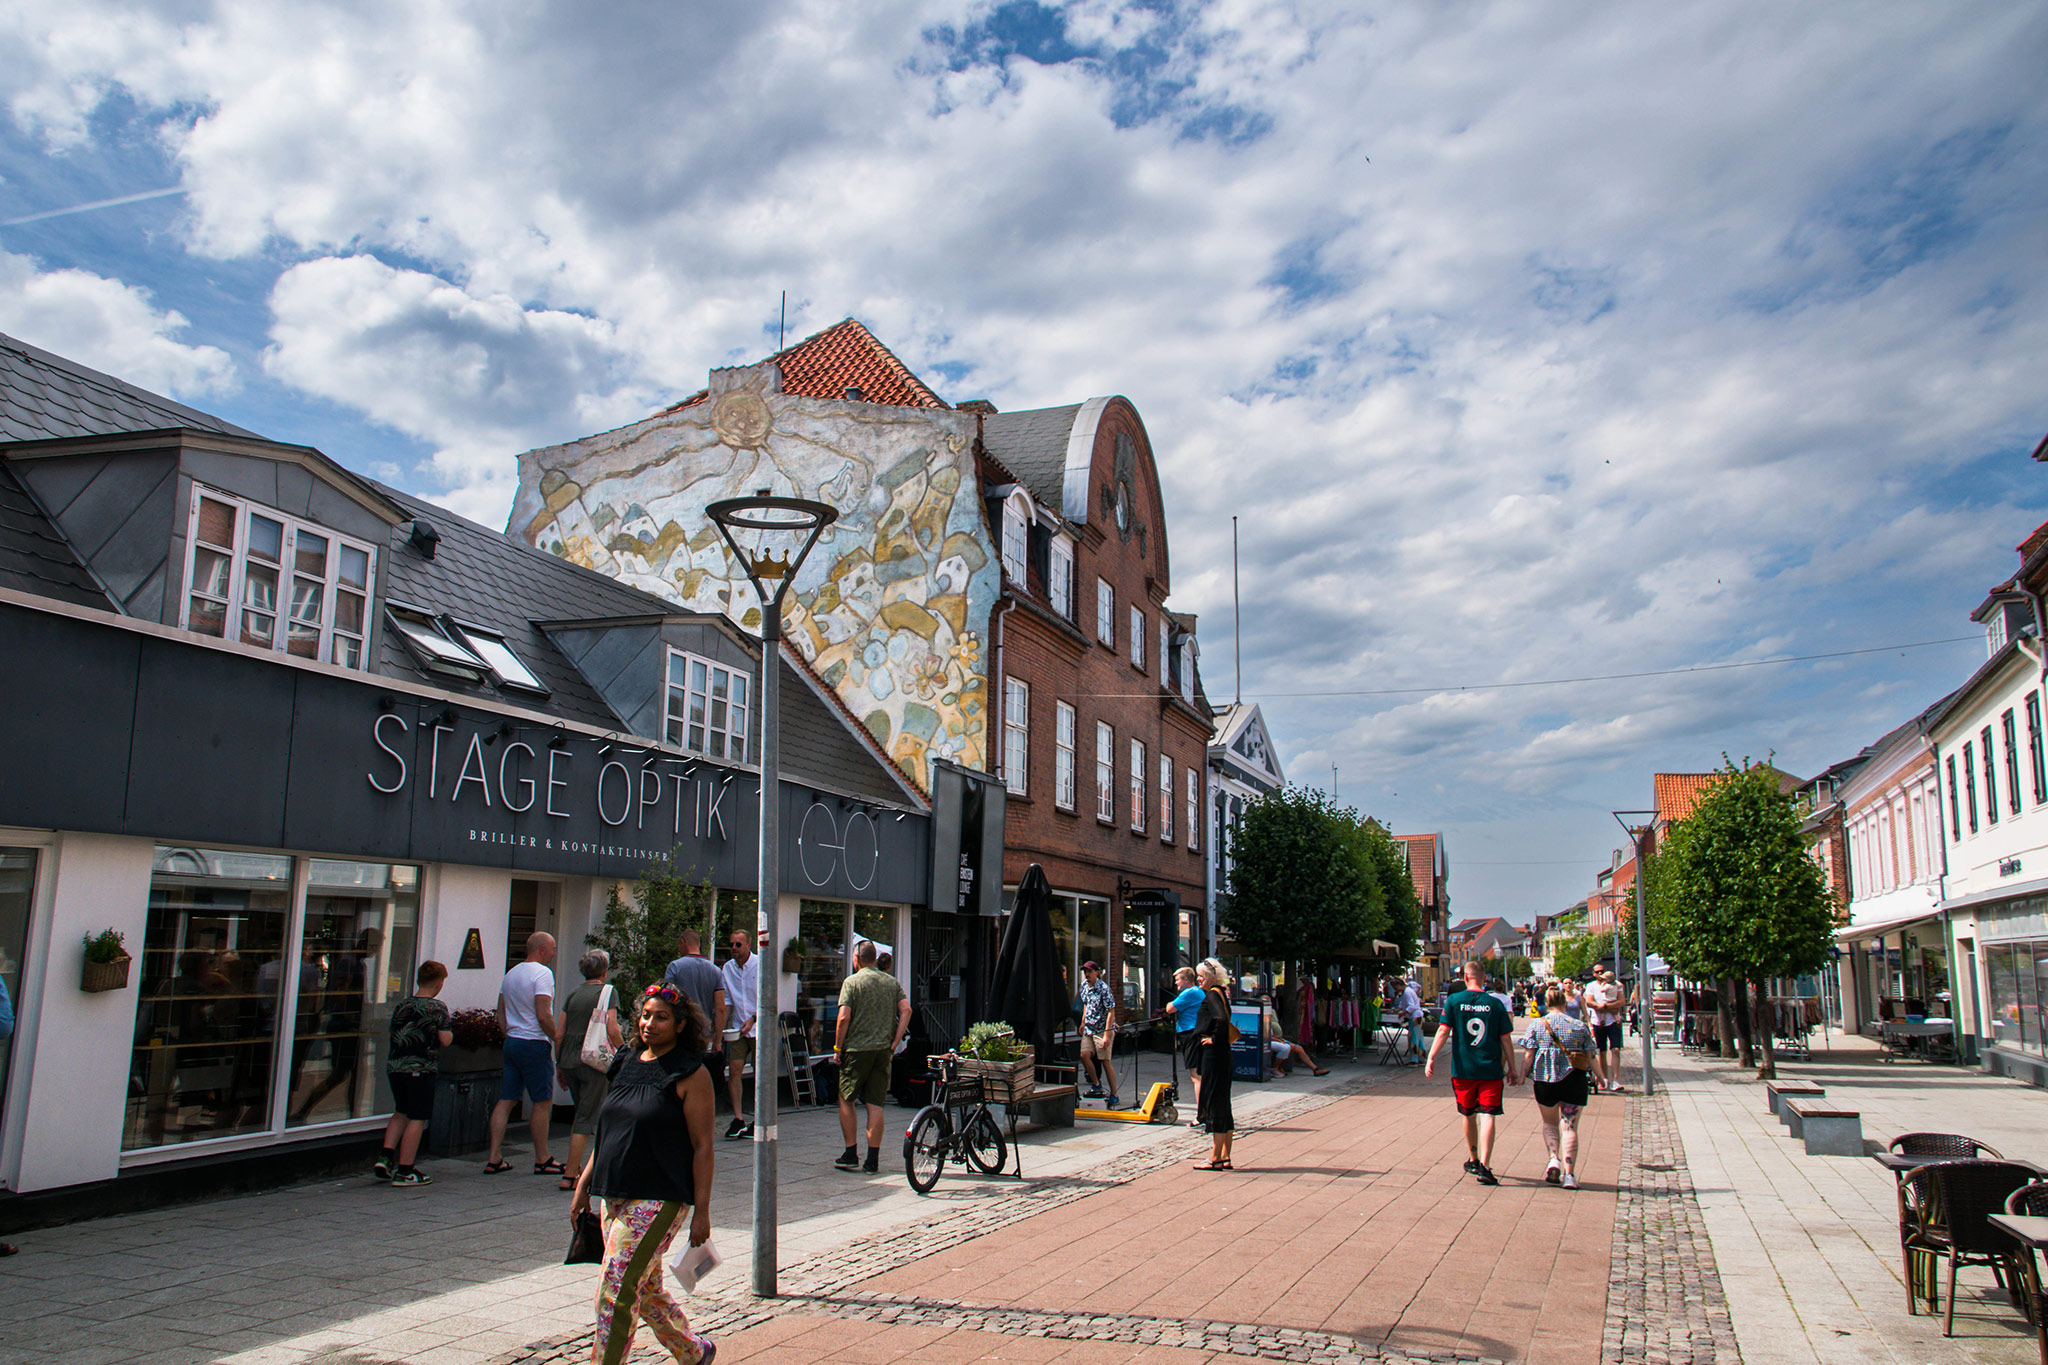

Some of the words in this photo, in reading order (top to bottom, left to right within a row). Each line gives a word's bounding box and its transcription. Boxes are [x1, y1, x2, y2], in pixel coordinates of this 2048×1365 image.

[367, 713, 574, 818] STAGE
[597, 761, 728, 841] OPTIK
[468, 829, 538, 848] BRILLER
[545, 838, 553, 849] &
[561, 840, 669, 862] KONTAKTLINSER
[1460, 1004, 1491, 1012] FIRMINO
[1466, 1017, 1486, 1047] 9
[949, 1089, 961, 1100] STAGE
